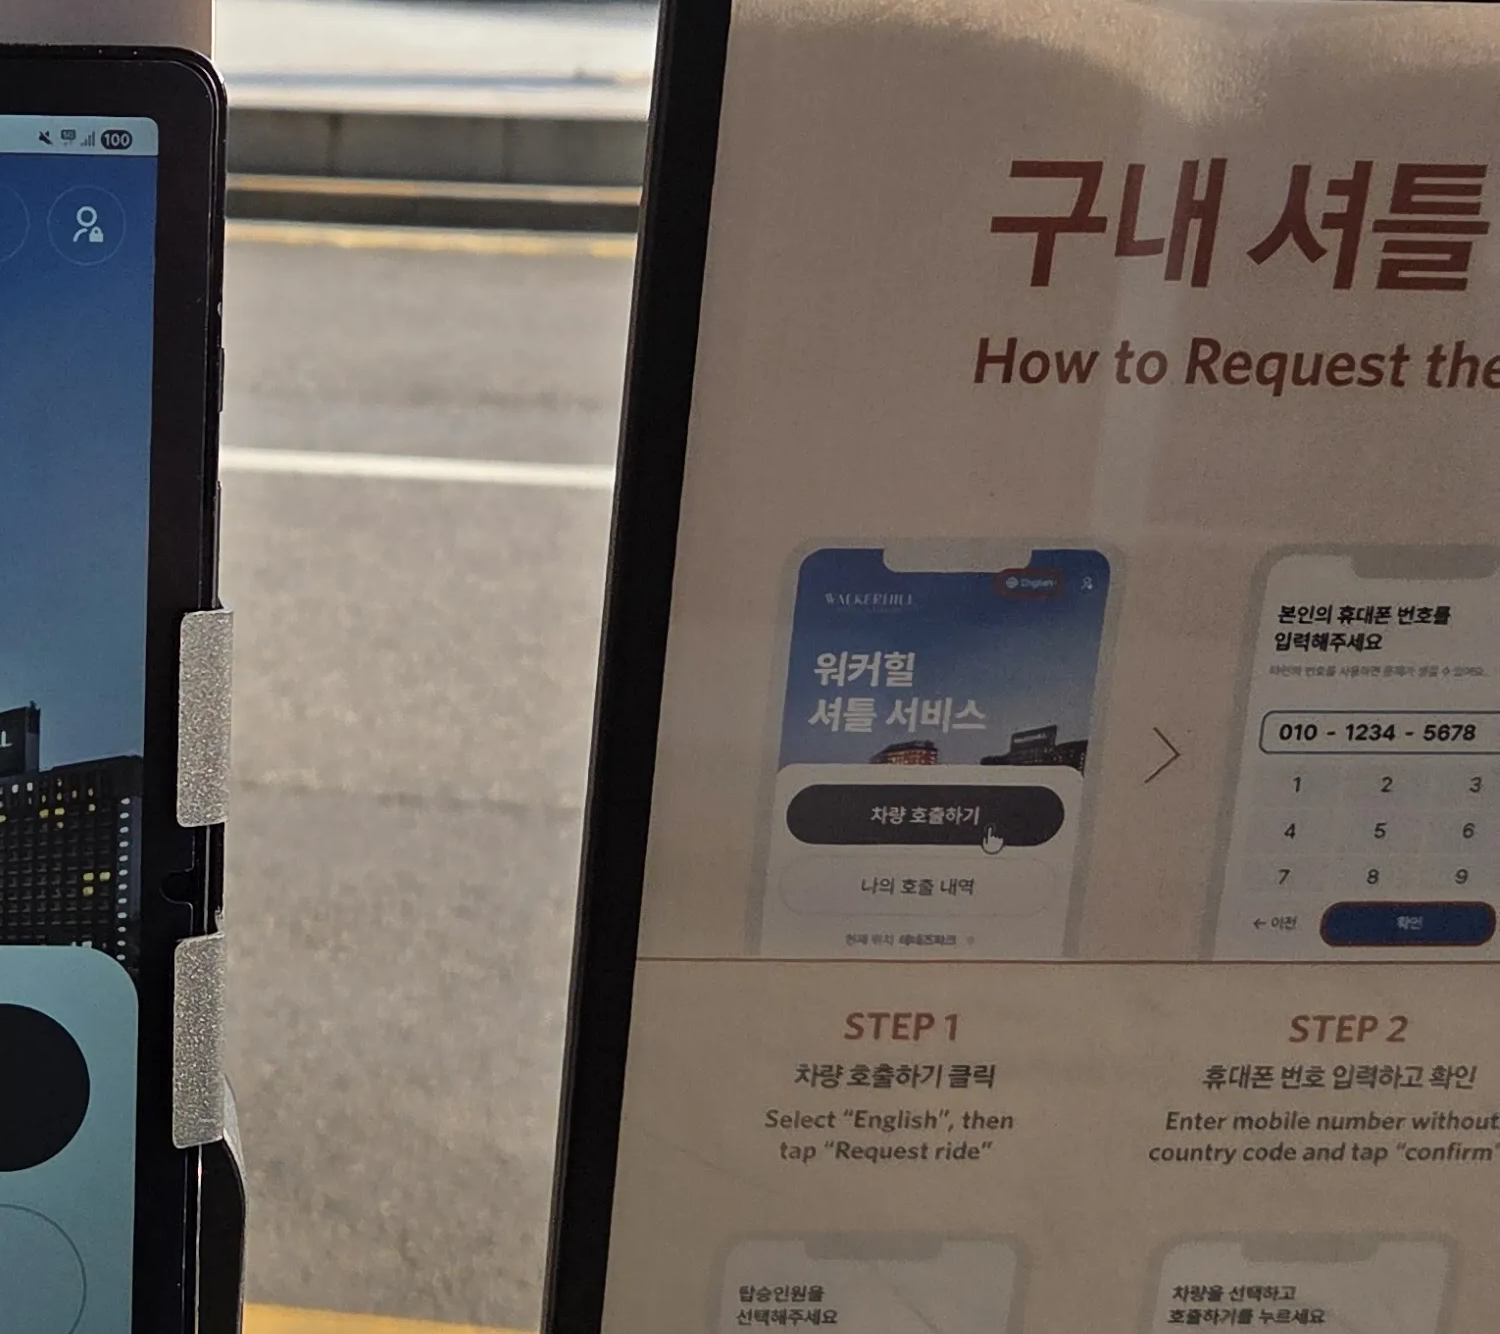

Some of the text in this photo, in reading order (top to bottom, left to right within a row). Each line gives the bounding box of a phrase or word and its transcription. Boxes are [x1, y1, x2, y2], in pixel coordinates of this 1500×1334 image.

[991, 158, 1490, 291] 구내 셔틀
[975, 337, 1099, 385] How
[1116, 339, 1167, 385] to
[1186, 338, 1407, 397] Request
[1277, 605, 1451, 625] 본인의 휴대폰 번호를
[1274, 632, 1384, 652] 입력해주세요
[814, 650, 916, 688] 워커힐
[808, 697, 987, 733] 셔틀 서비스
[1279, 723, 1477, 742] 010 1234 5678
[1292, 776, 1483, 793] 1 2 3
[870, 805, 980, 826] 차량 호출하기
[1283, 822, 1476, 840] 4 5 6
[860, 877, 975, 896] 나의 호출 내역
[1277, 869, 1469, 885] 7 8 9
[844, 1012, 960, 1041] STEP 1
[1288, 1014, 1409, 1044] STEP 2
[794, 1063, 997, 1088] 차량 호출하기 클릭
[1202, 1063, 1478, 1090] 휴대폰 번호 입력하고 확인
[764, 1108, 1014, 1130] Select then
[1165, 1110, 1500, 1132] Enter mobile number without
[780, 1141, 817, 1164] tap
[1148, 1142, 1389, 1166] country code and tap
[738, 1284, 825, 1304] 탑승인원을
[1172, 1285, 1297, 1303] 차량을 선택하고
[736, 1308, 839, 1327] 선택해주세요
[1167, 1308, 1326, 1326] 호출하기를 누르세요
